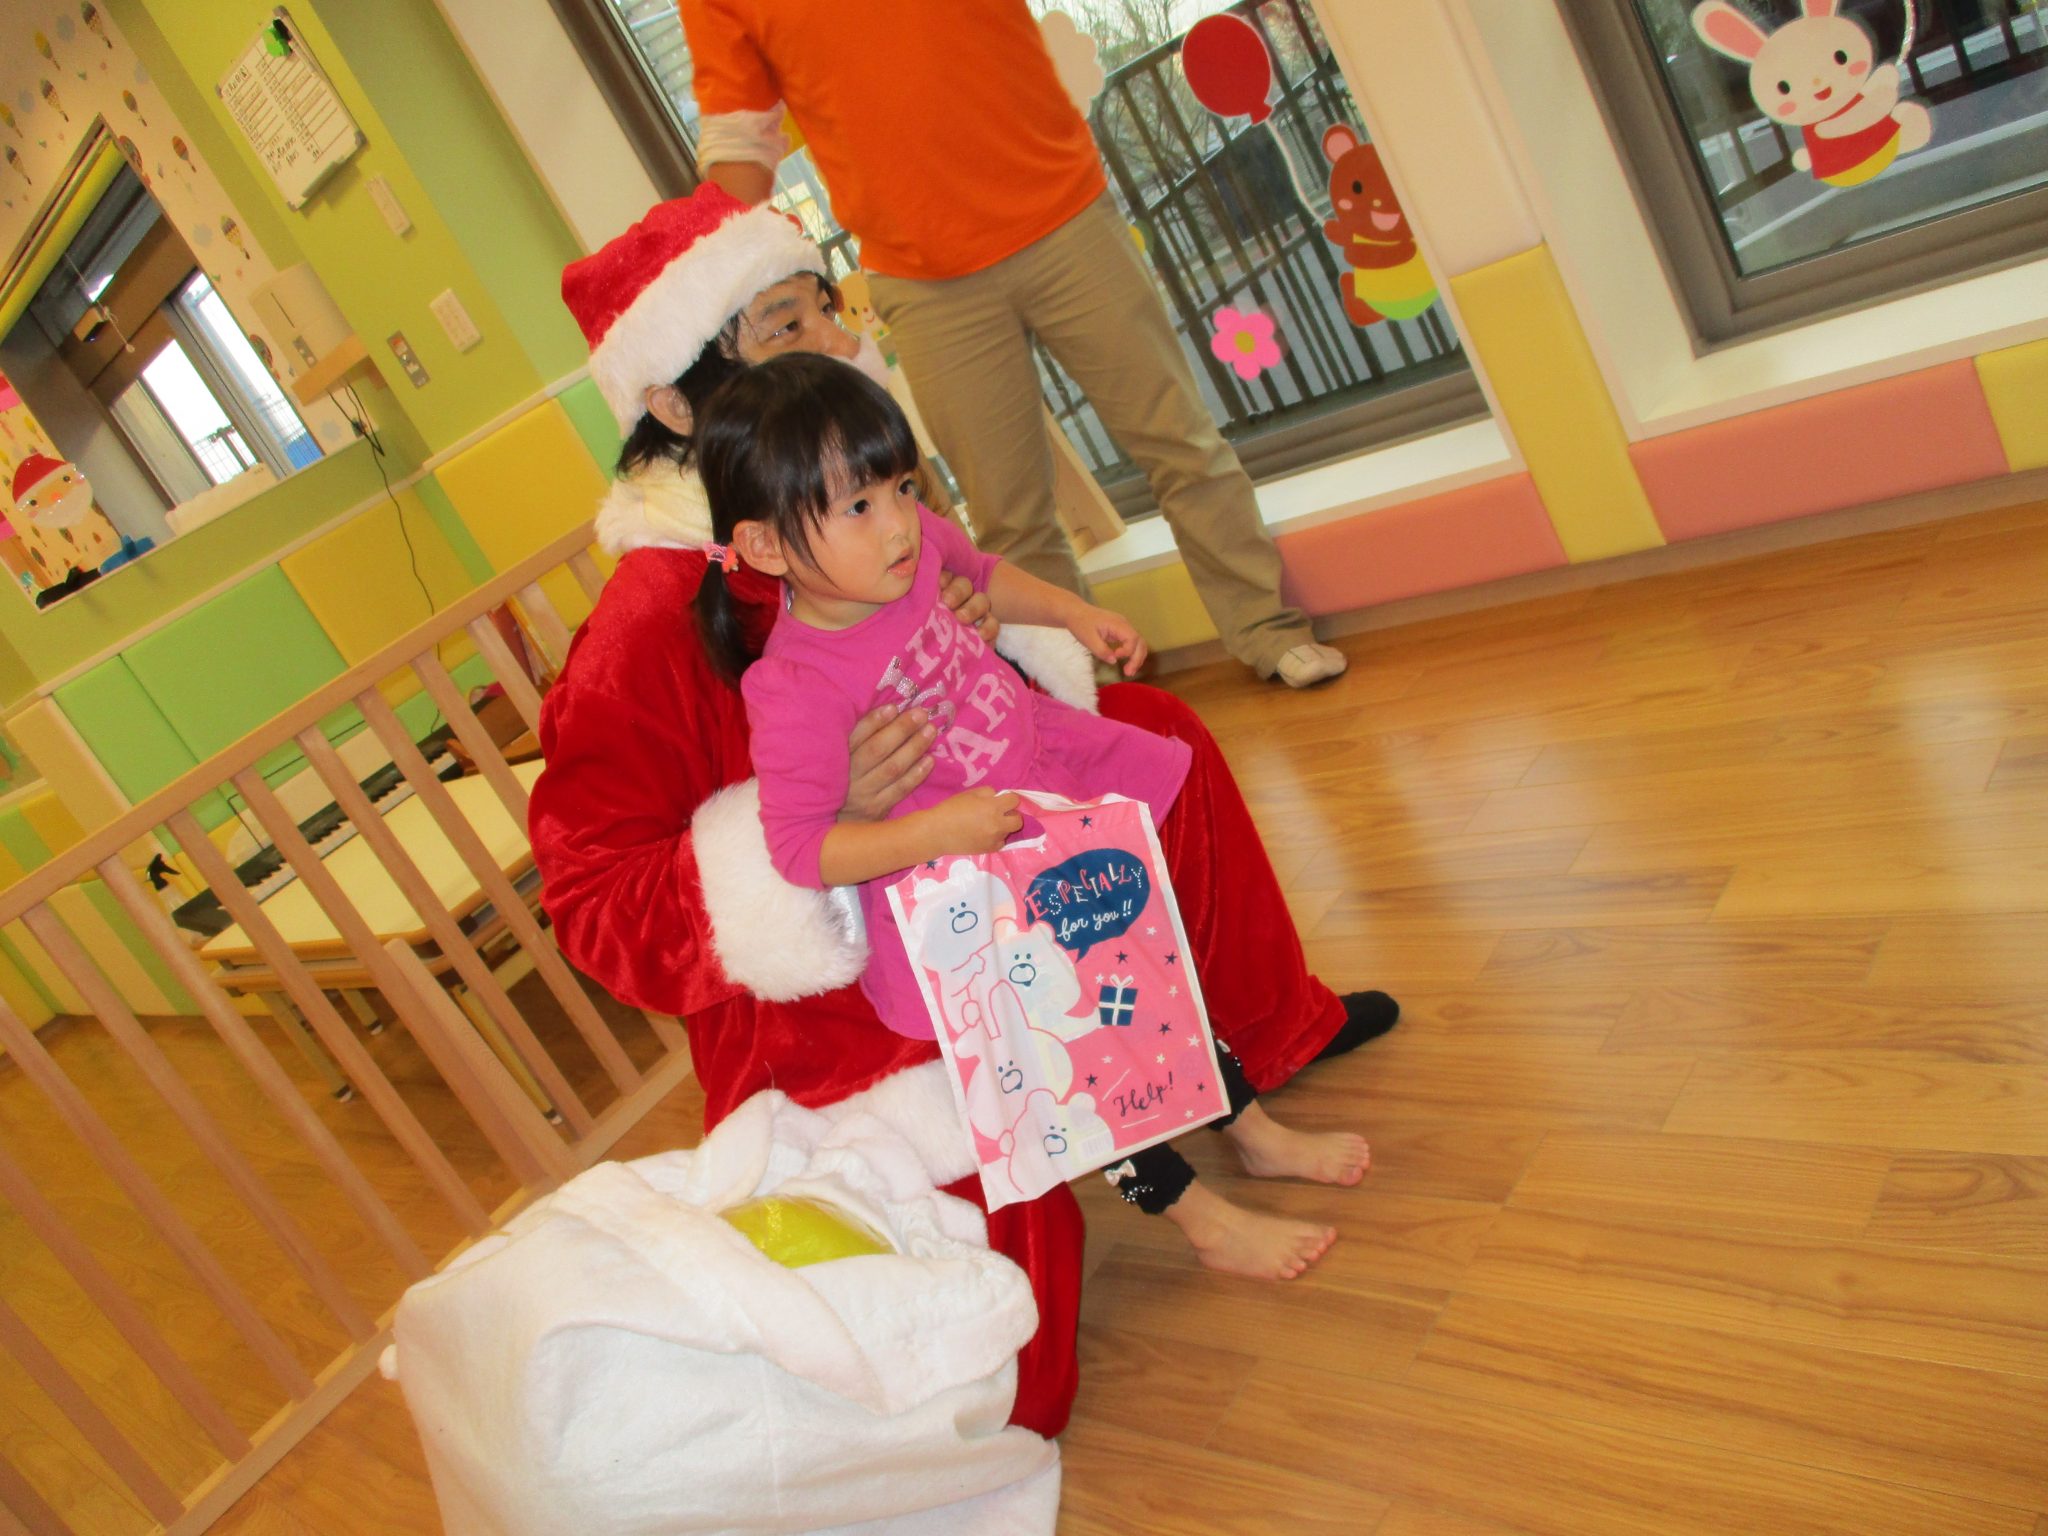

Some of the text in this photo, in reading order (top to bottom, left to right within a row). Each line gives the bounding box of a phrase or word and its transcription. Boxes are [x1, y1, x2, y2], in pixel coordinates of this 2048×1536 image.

[1024, 862, 1143, 919] ESPECIALLY
[1057, 917, 1088, 941] for
[1113, 1071, 1173, 1116] Help!
